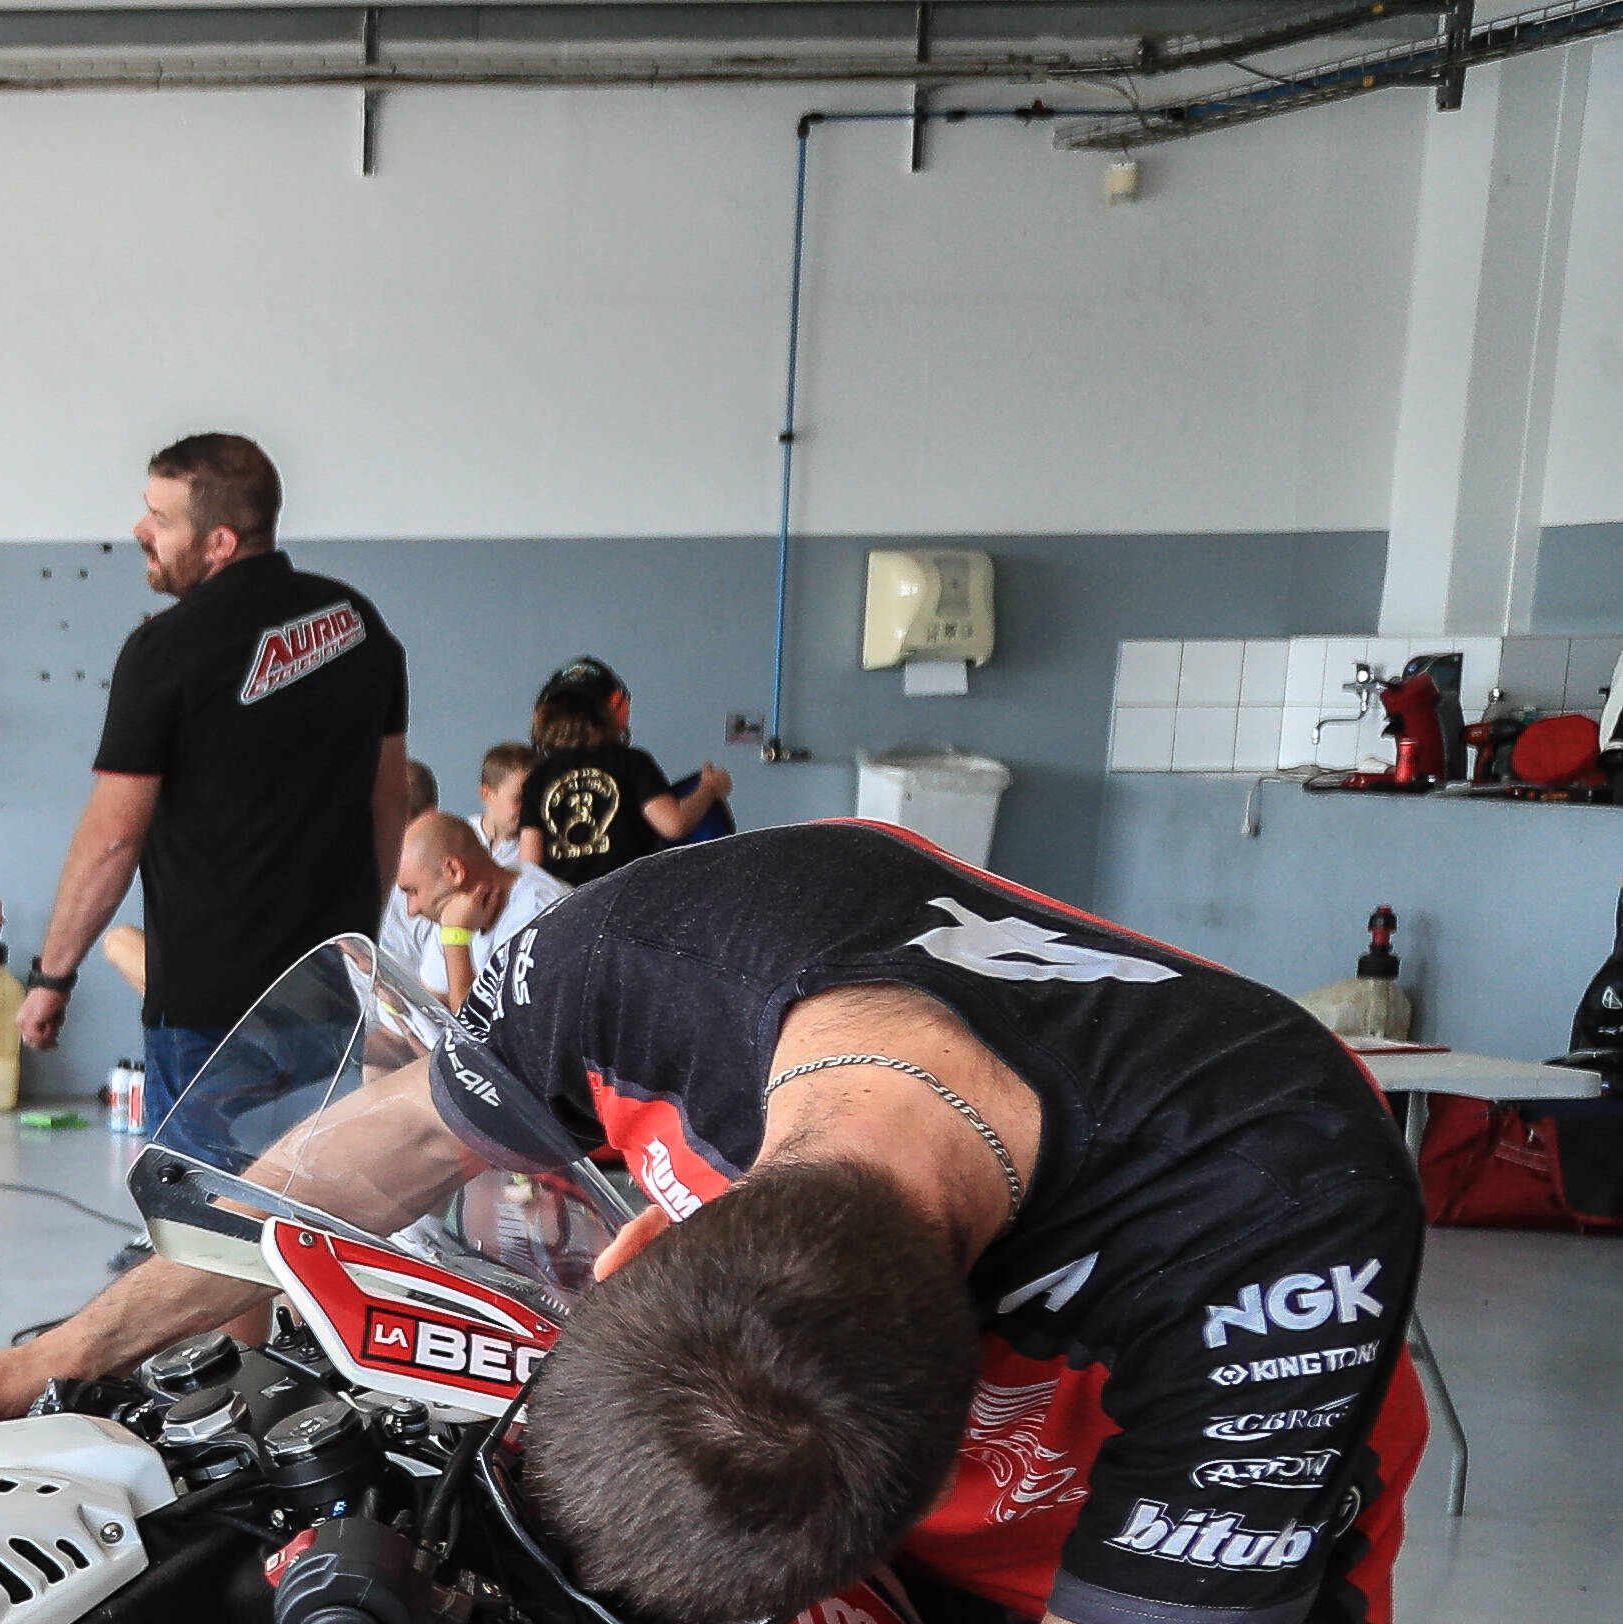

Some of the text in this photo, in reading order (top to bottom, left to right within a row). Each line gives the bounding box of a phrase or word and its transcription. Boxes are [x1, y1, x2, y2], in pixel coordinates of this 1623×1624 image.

[1205, 1258, 1383, 1349] NGK
[374, 1323, 409, 1348] LA
[1249, 1352, 1322, 1382] KING
